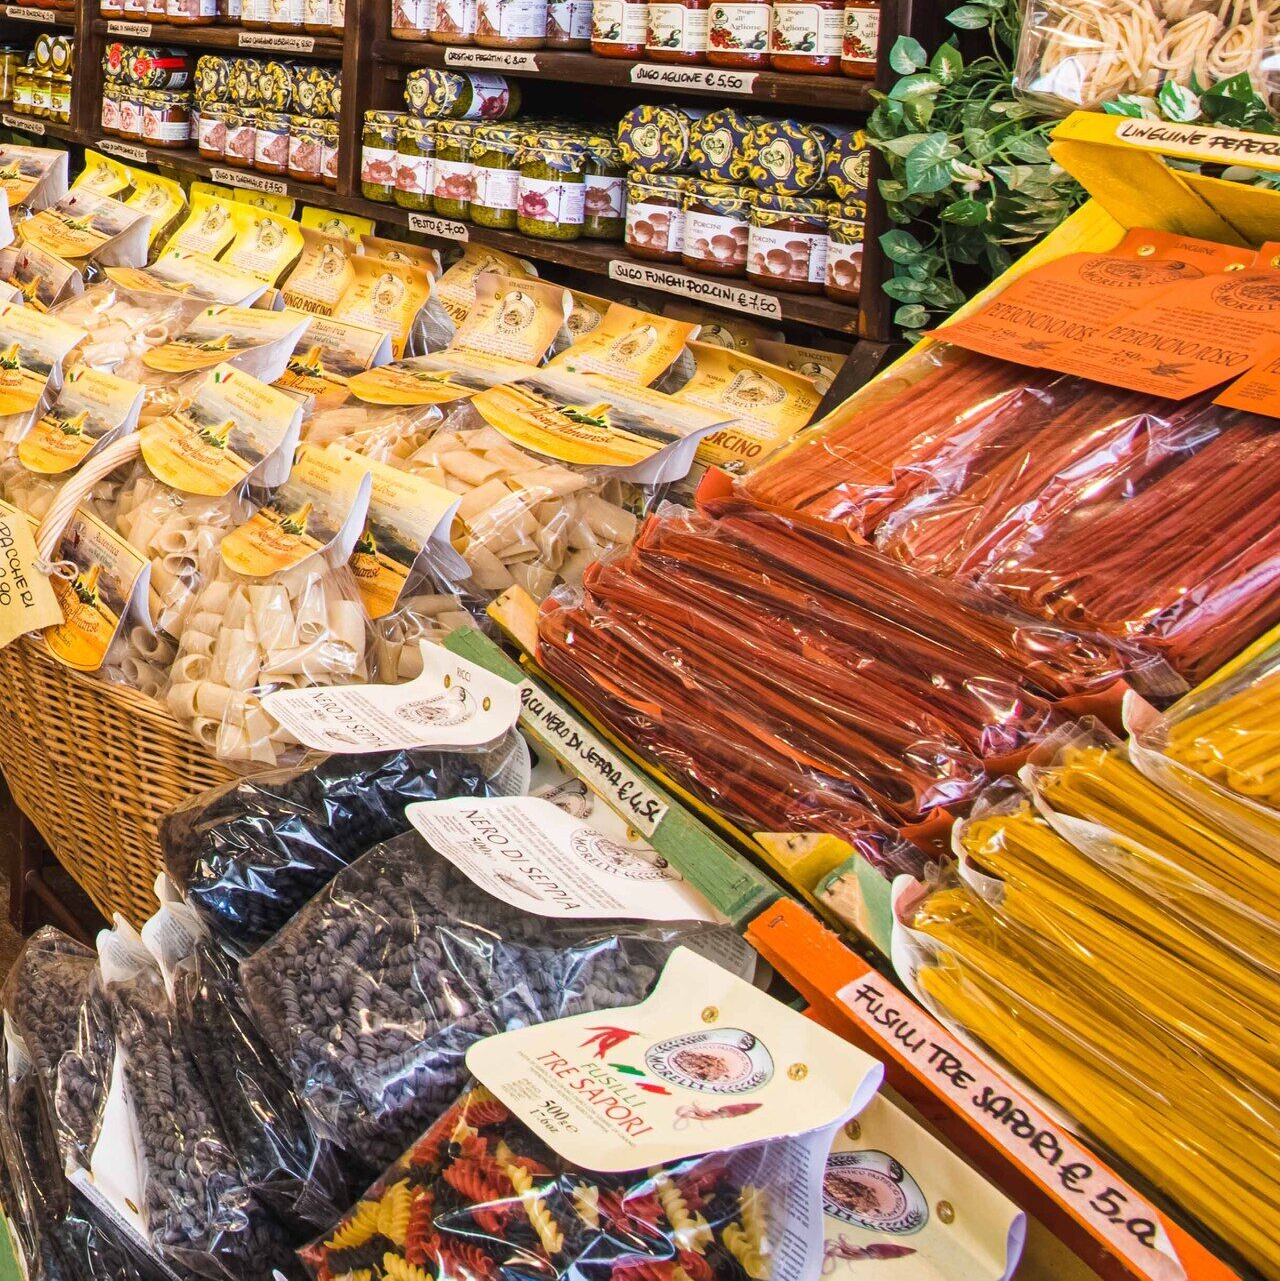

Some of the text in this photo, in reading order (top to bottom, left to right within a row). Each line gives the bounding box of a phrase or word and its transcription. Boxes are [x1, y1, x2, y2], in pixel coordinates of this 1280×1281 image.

[731, 22, 762, 32] Aglione
[780, 23, 810, 32] Aglione
[636, 67, 743, 90] SUGO AGLIONE € 5,50
[1121, 122, 1207, 147] LINGUINE
[411, 216, 465, 236] PESTO € 7,00
[693, 219, 722, 231] PORCINI
[752, 233, 777, 245] PORCINI
[1174, 241, 1218, 257] LINGUINE
[615, 264, 778, 314] SUGO FUNGHI PORCINI € 7,50
[302, 299, 334, 318] PORCINO
[986, 301, 1062, 337] PEPERONCINO
[312, 319, 348, 337] Autentica
[1102, 325, 1252, 369] PEPERONCINO ROSSO
[94, 531, 121, 559] Autentica
[456, 665, 472, 684] RICCI
[306, 690, 337, 717] NERO
[350, 720, 390, 749] SEPPIA
[544, 711, 571, 740] NERO
[566, 730, 585, 752] DI
[579, 741, 622, 788] SEPPIA
[460, 809, 582, 912] NERO DI SEPPIA
[573, 837, 621, 877] MORELLI
[580, 1061, 648, 1109] FUSILLI
[647, 1054, 707, 1093] MORELLI
[536, 1049, 656, 1139] TRE SAPORI
[854, 983, 1094, 1195] FUSILLI TRE SAPORI €
